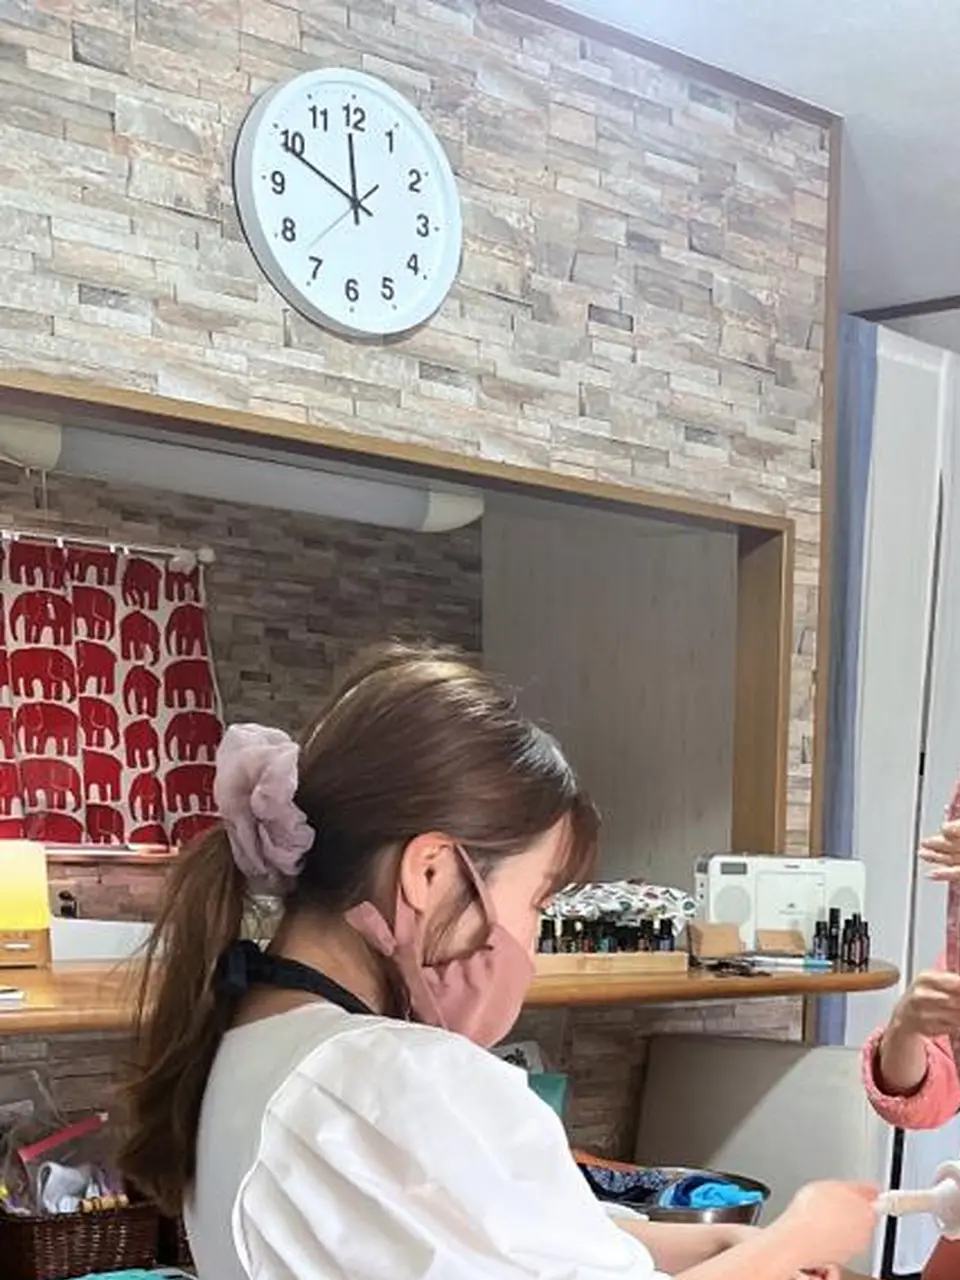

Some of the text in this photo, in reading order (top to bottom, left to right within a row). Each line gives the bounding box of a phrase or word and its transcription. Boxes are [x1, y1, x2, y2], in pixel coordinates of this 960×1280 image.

[308, 105, 329, 132] 11
[342, 103, 367, 132] 12
[280, 129, 305, 157] 10
[385, 130, 394, 154] 1
[270, 170, 286, 195] 9
[408, 168, 422, 193] 2
[281, 217, 297, 242] 8
[416, 213, 430, 238] 3
[308, 255, 324, 280] 7
[406, 253, 420, 276] 4
[345, 278, 360, 302] 6
[381, 276, 395, 301] 5
